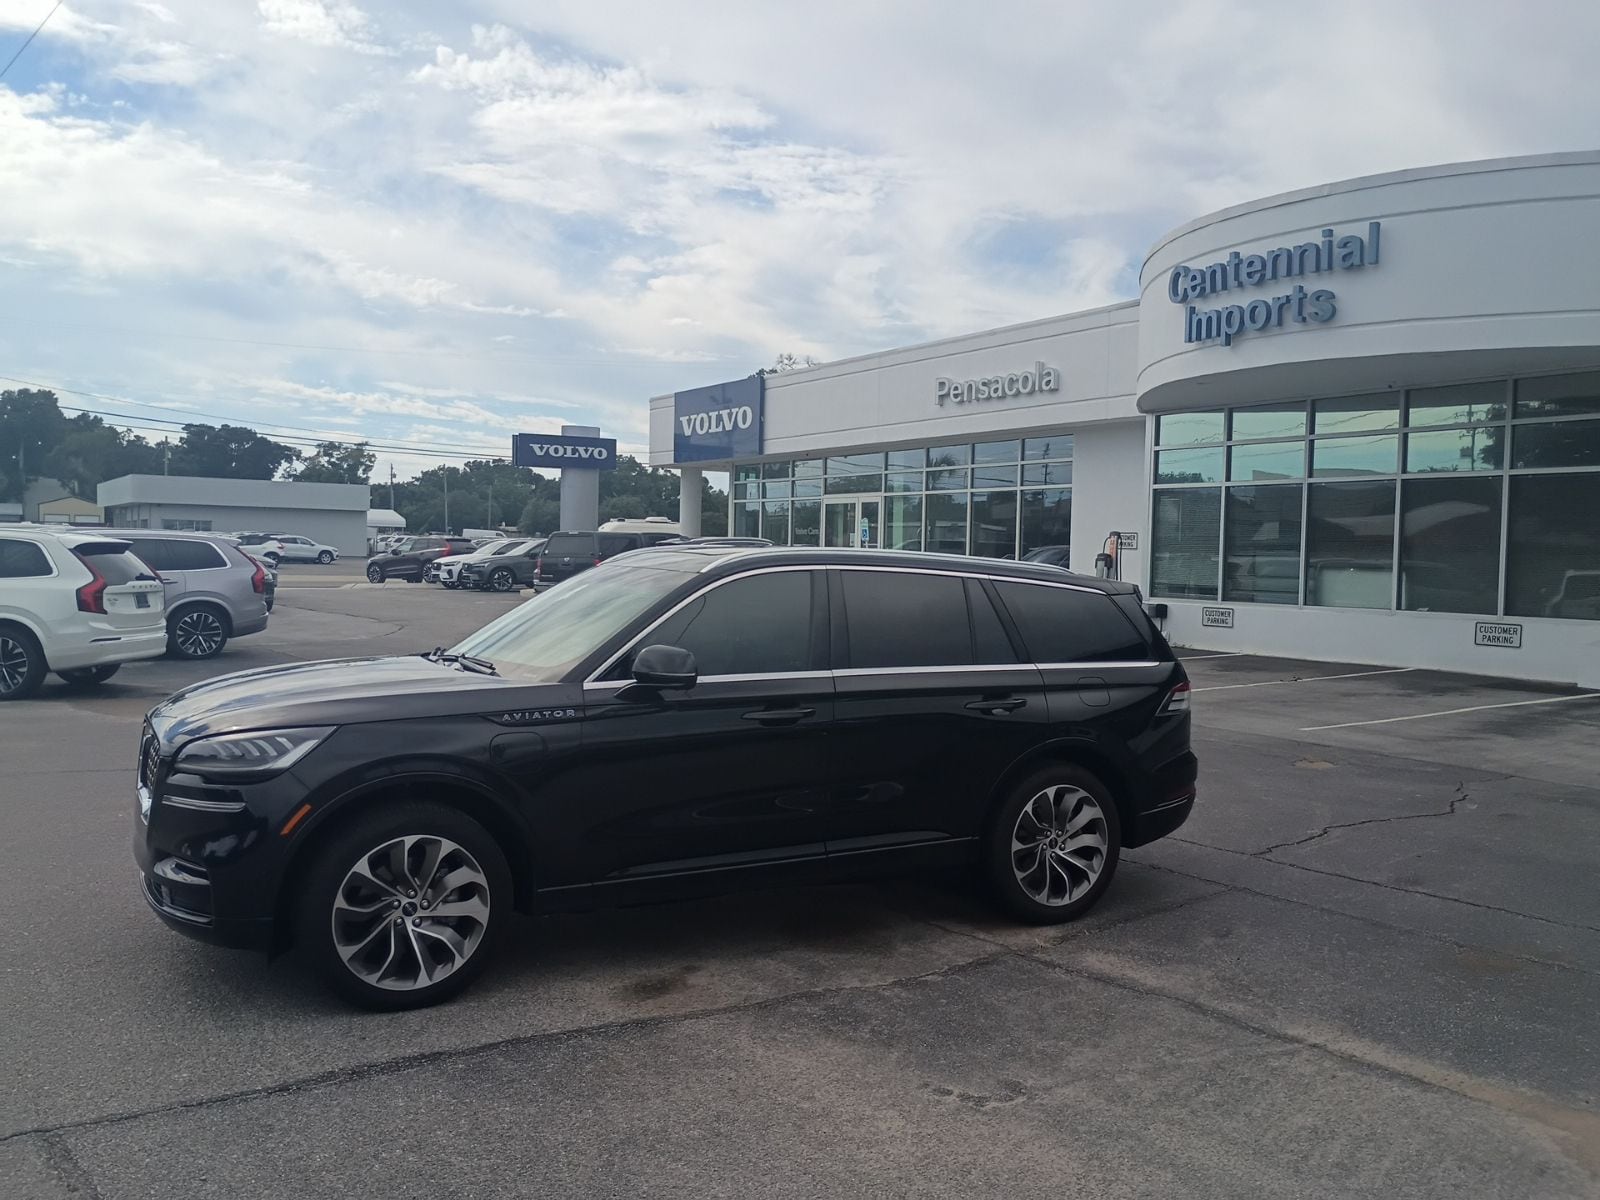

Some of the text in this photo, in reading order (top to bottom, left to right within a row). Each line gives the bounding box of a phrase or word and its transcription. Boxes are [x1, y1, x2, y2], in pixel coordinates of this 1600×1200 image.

[1168, 221, 1381, 303] Centennial
[1184, 285, 1337, 346] Imports
[935, 361, 1060, 406] Pensacola
[680, 406, 752, 437] VOLVO
[529, 443, 608, 459] VOLVO
[1479, 626, 1518, 636] CUSTOMER
[1482, 634, 1514, 644] PARKING
[502, 709, 575, 721] AVIATOR
